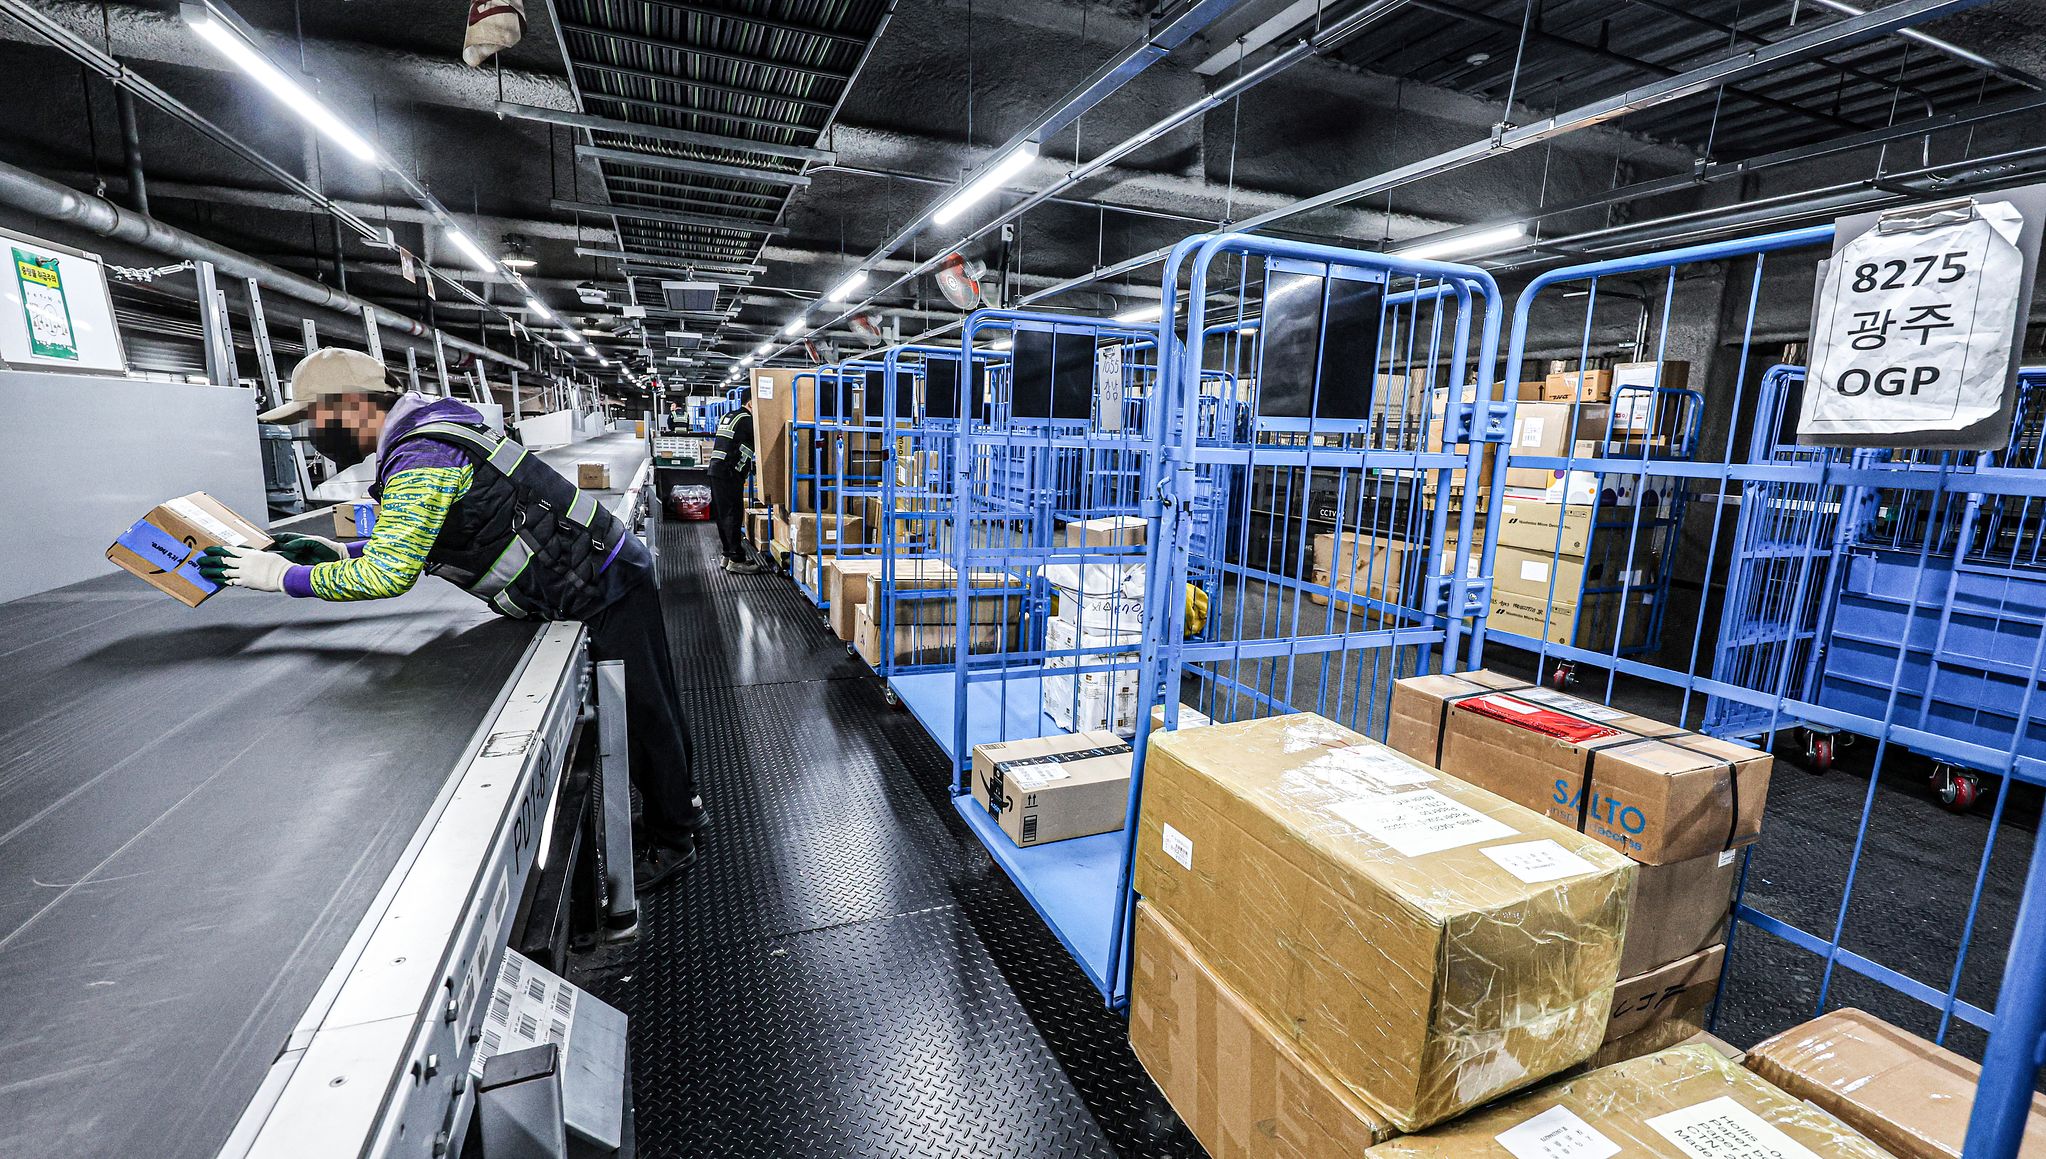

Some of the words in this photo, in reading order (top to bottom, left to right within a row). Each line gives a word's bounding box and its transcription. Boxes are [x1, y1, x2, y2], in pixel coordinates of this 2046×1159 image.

[1851, 251, 1969, 293] 8275
[1847, 303, 1955, 351] 광주
[1836, 366, 1941, 397] OGP
[1549, 806, 1643, 852] inspdaccss
[1674, 1129, 1713, 1158] Made
[1686, 1125, 1723, 1151] CTN:
[1698, 1122, 1741, 1152] Paper
[1709, 1119, 1752, 1149] Paper
[1719, 1115, 1758, 1142] Hollis
